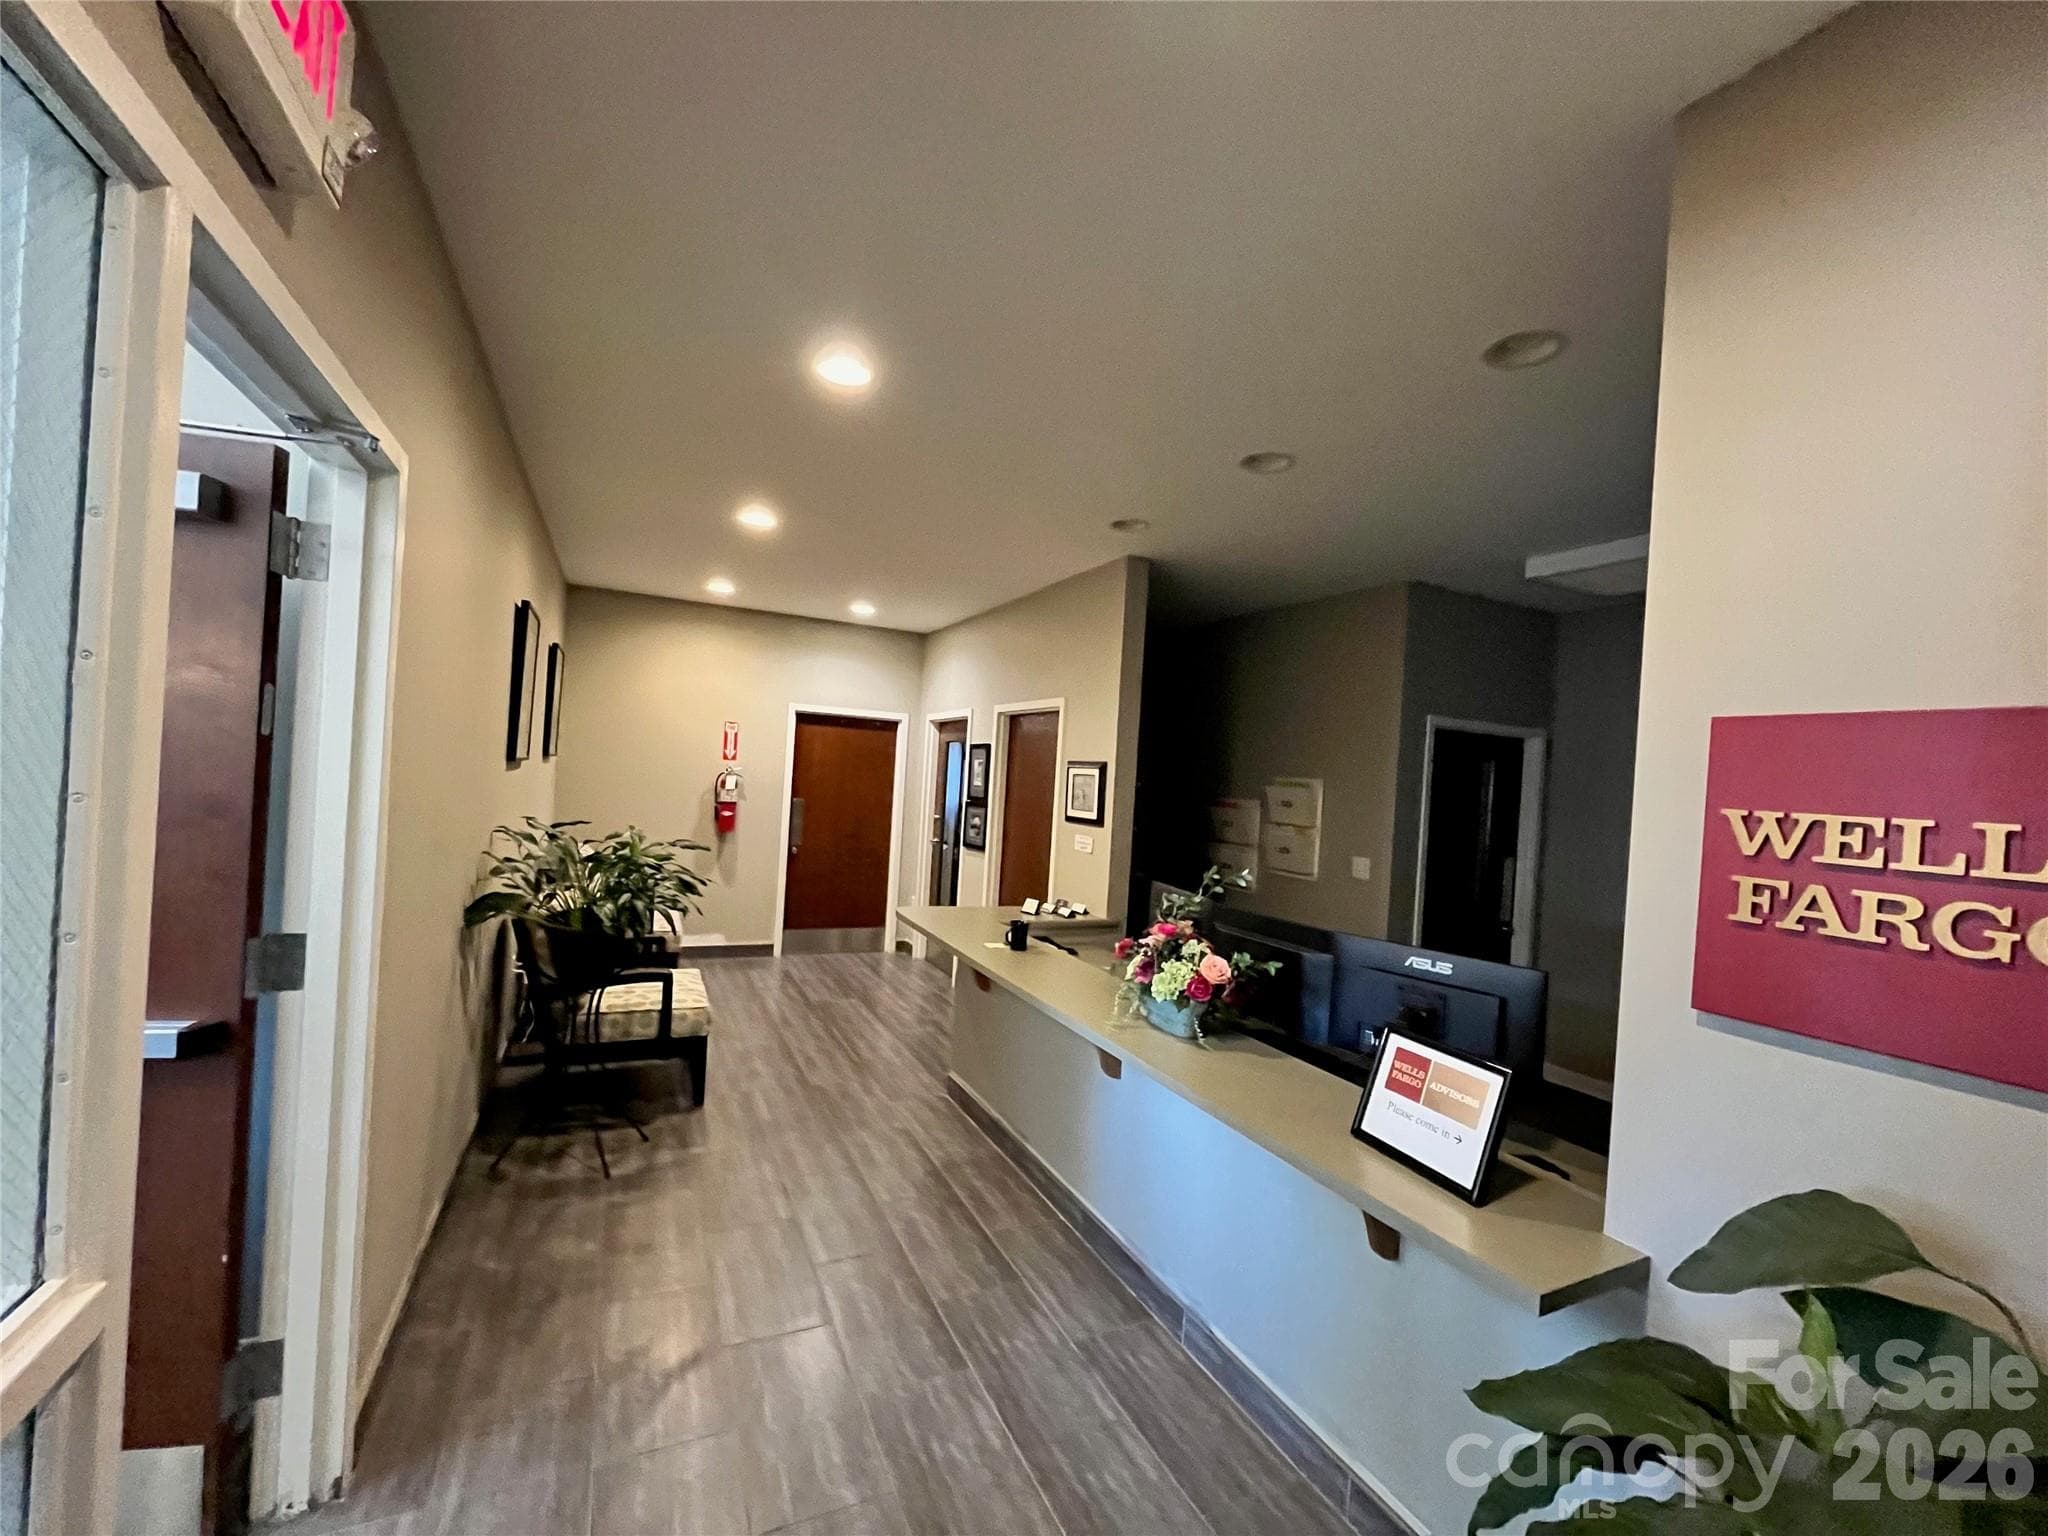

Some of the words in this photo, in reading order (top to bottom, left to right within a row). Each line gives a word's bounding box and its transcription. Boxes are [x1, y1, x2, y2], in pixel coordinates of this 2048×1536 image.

[1727, 875, 2048, 967] FARG
[1404, 956, 1454, 975] ASUS
[1391, 1069, 1422, 1089] FARGO
[1394, 1059, 1426, 1080] WELLS
[1429, 1081, 1481, 1108] ADVISORS
[1387, 1100, 1414, 1122] Please
[1415, 1117, 1440, 1134] come
[1441, 1128, 1451, 1140] in
